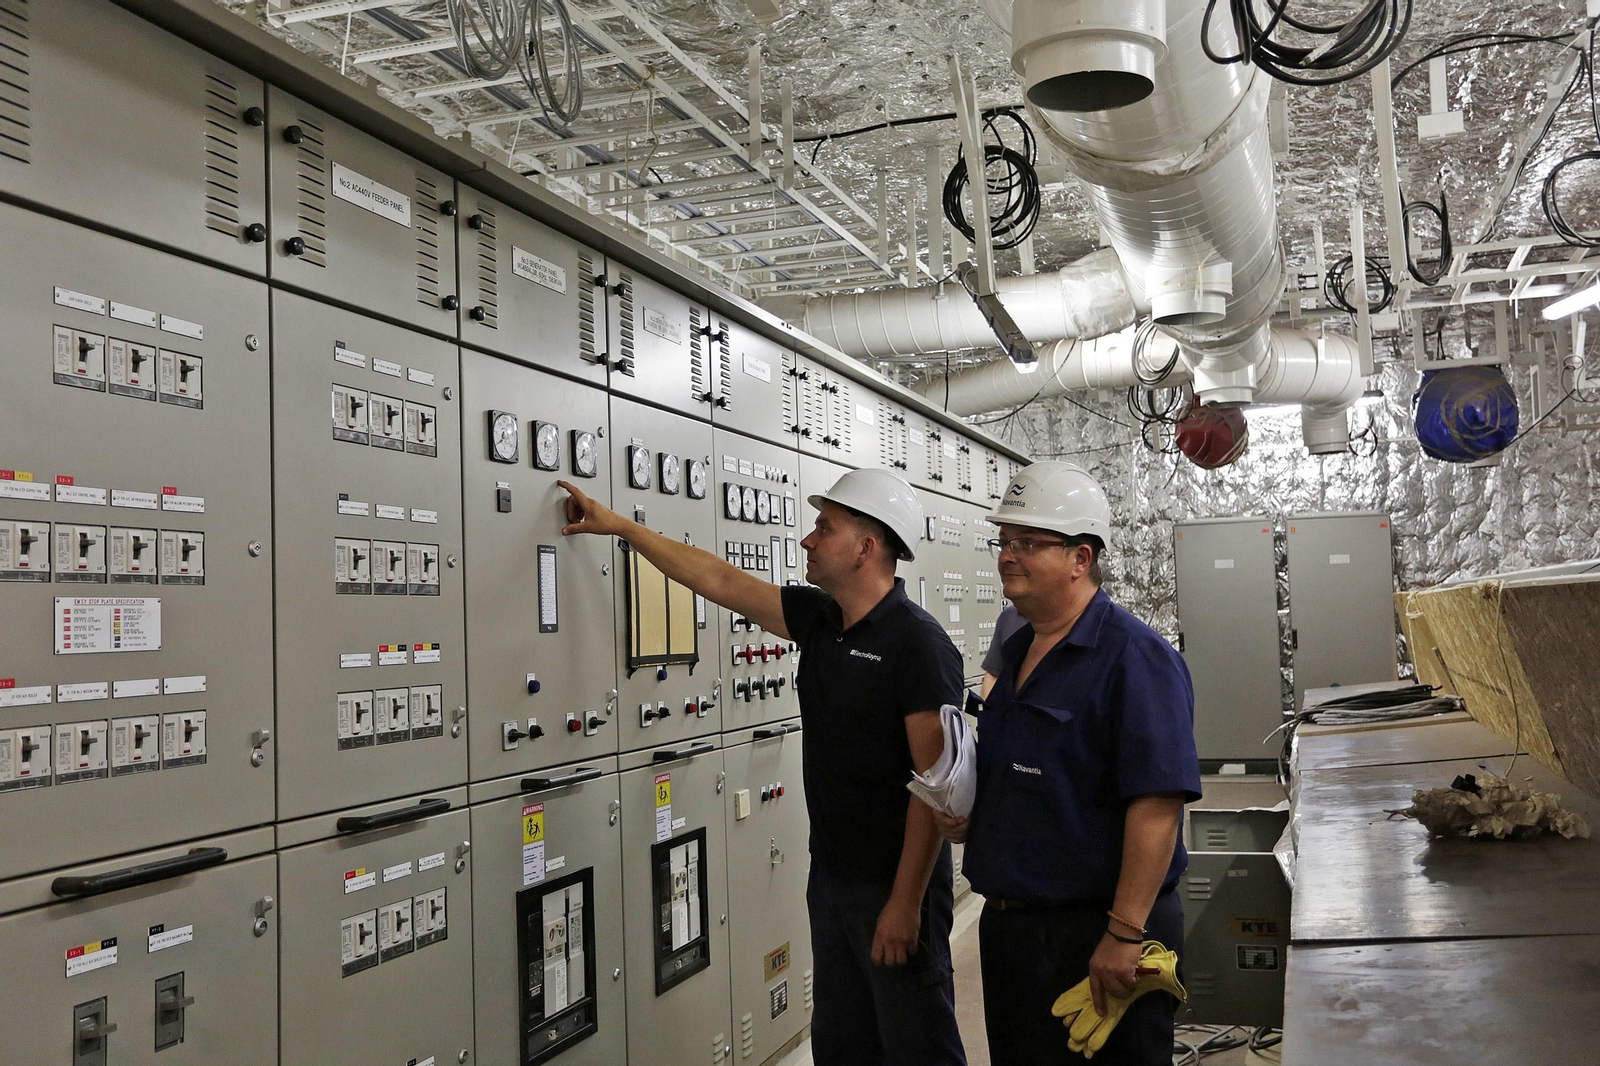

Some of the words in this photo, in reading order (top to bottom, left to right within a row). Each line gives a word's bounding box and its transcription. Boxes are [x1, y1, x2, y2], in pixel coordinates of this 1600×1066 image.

[339, 178, 350, 188] No.2
[372, 193, 389, 206] FEEDER
[390, 201, 404, 214] PANEL
[1241, 922, 1277, 932] KTE
[772, 950, 786, 970] KTE
